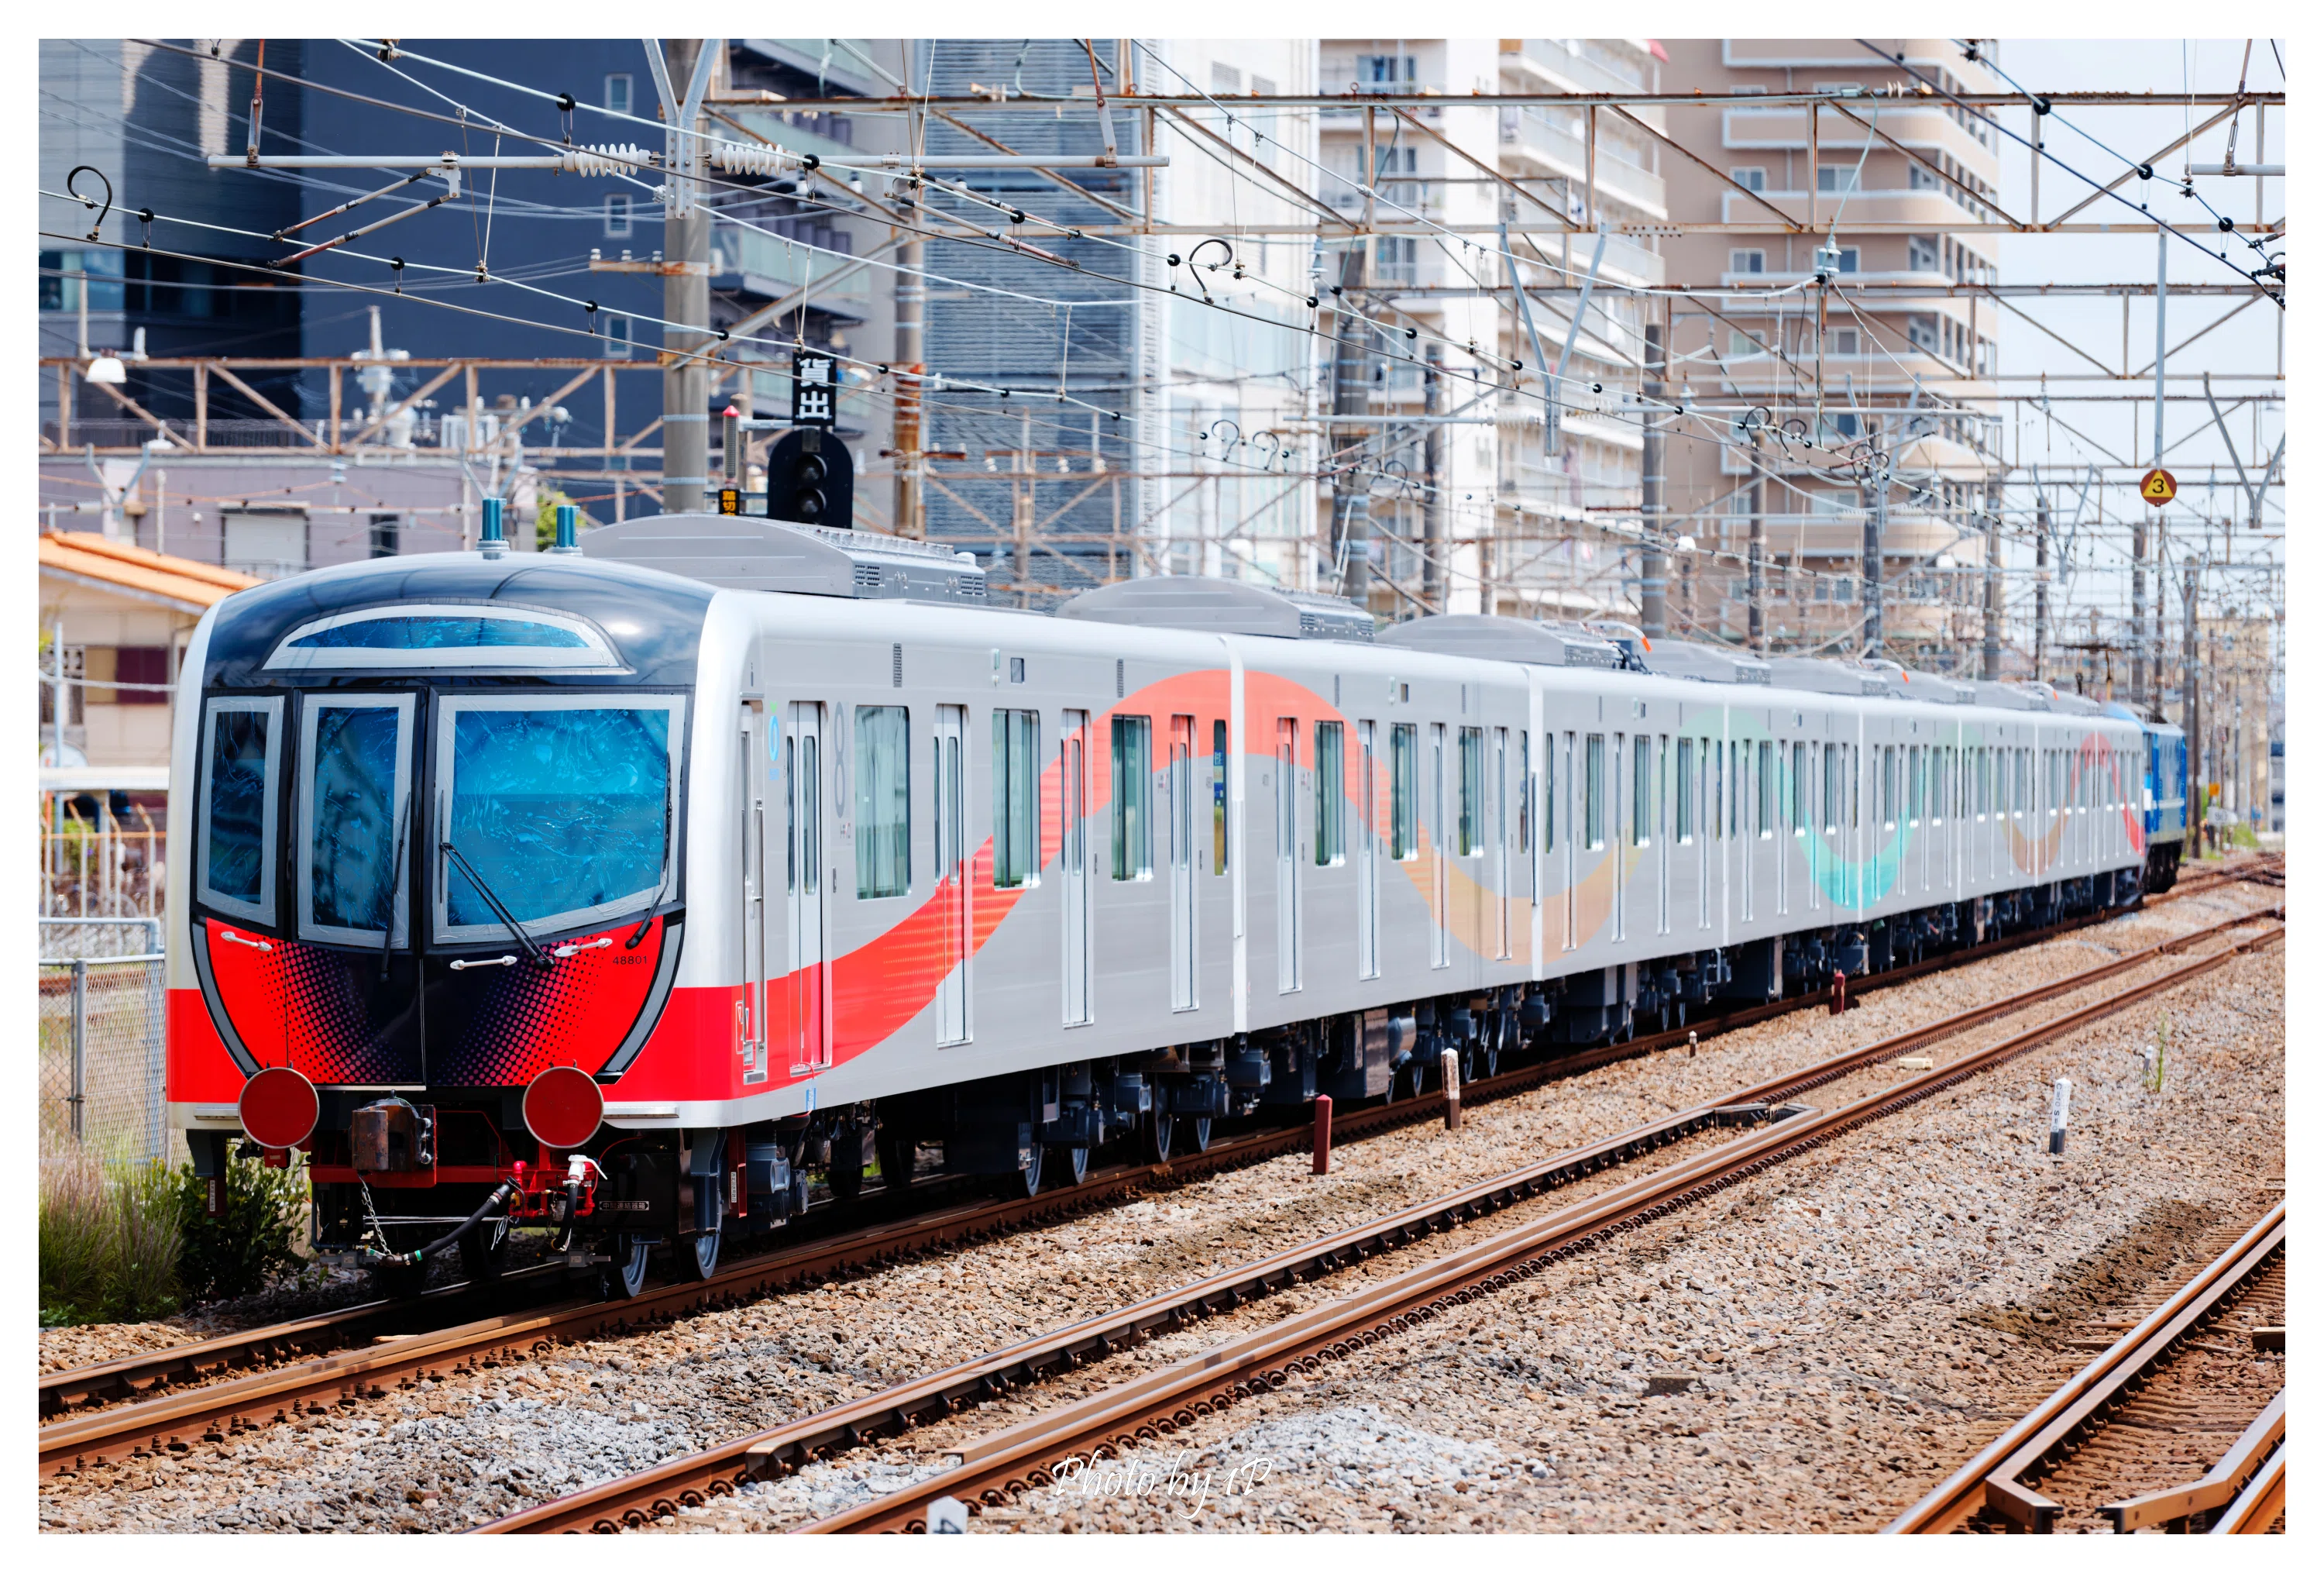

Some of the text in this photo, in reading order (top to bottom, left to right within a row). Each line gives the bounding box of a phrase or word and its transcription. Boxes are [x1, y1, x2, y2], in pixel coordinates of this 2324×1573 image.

[799, 358, 831, 420] 貨出
[2152, 478, 2164, 494] 3
[612, 955, 648, 965] 48801
